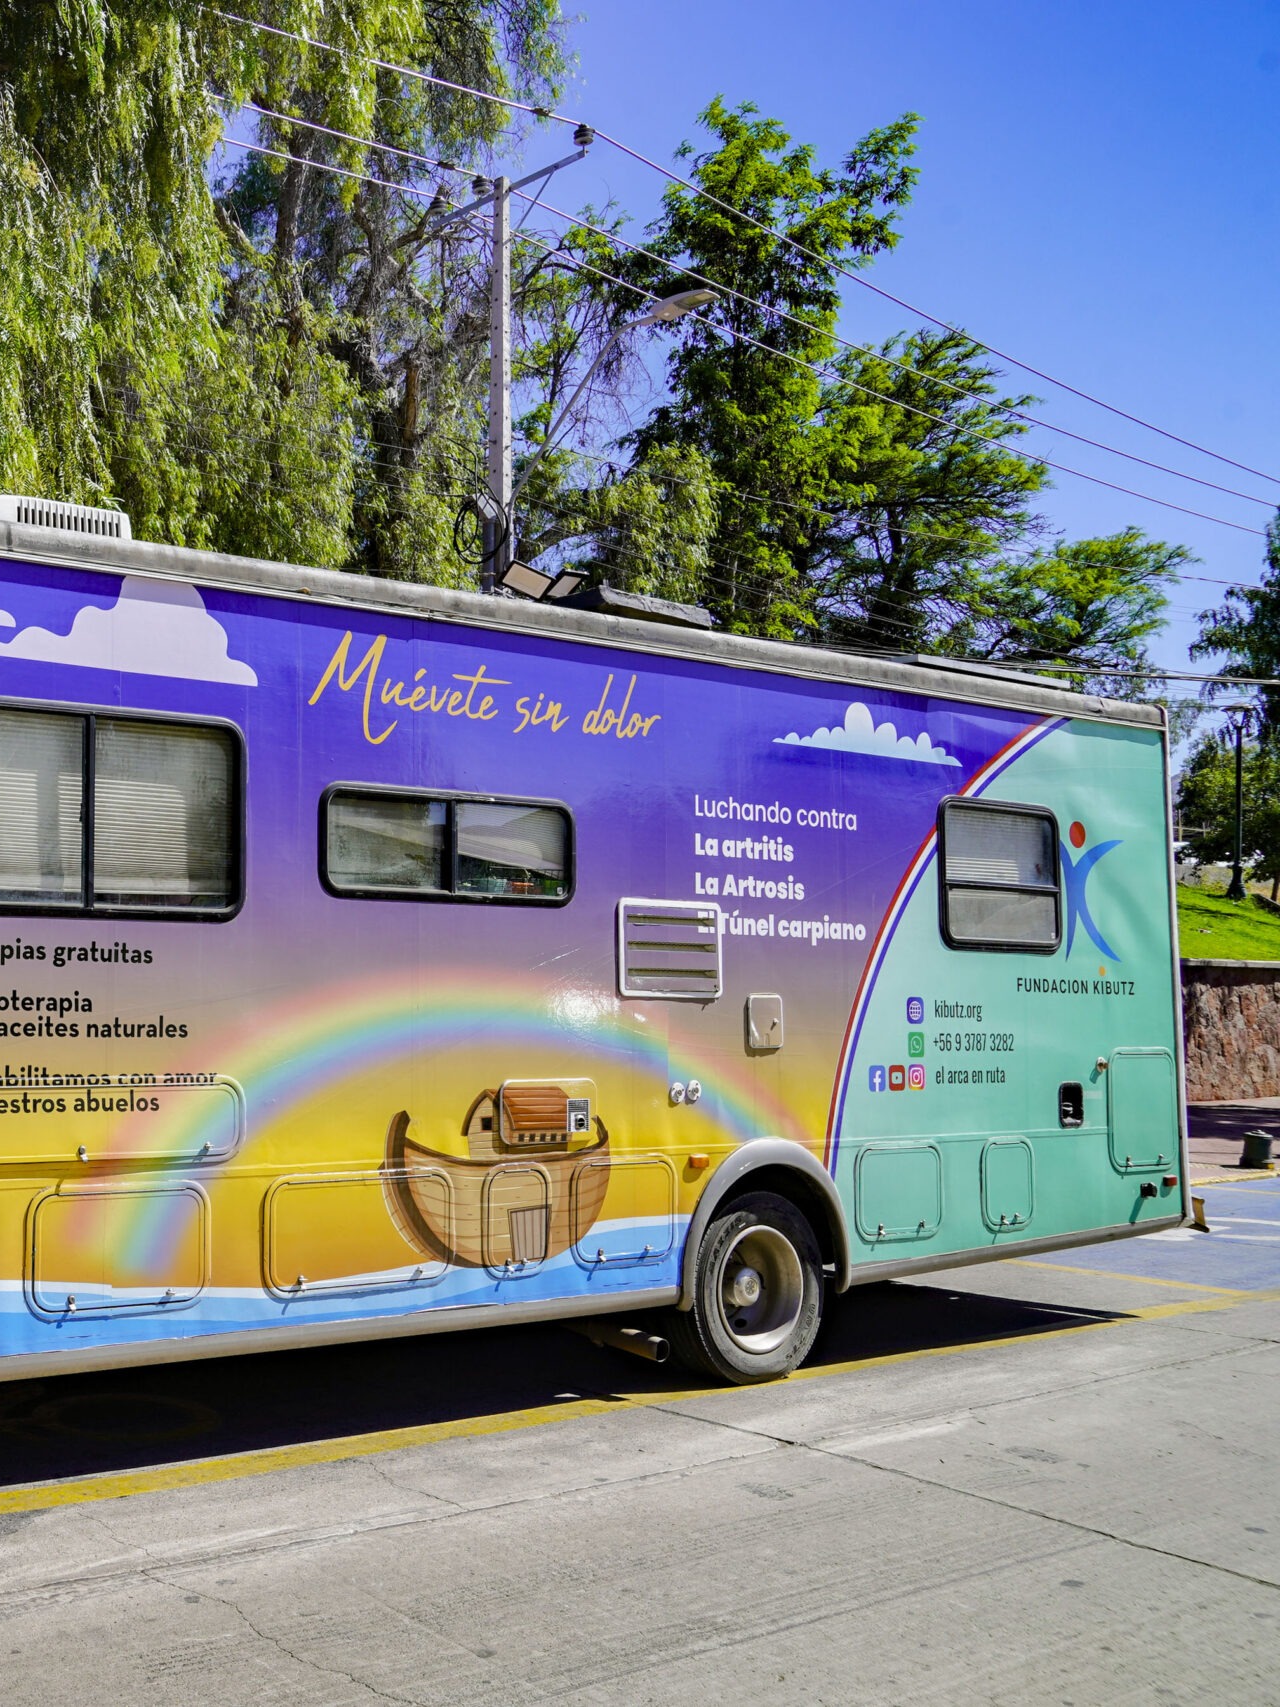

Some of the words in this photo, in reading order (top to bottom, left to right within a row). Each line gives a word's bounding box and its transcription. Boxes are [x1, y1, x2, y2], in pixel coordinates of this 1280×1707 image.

[308, 630, 513, 745] Muévete
[513, 692, 569, 734] sin
[582, 673, 662, 739] dolor
[694, 794, 792, 824] Luchando
[796, 807, 858, 831] contra
[694, 832, 719, 857] La
[722, 835, 795, 862] artritis
[694, 872, 719, 896] La
[722, 873, 805, 901] Artrosis
[718, 909, 775, 937] Túnel
[778, 914, 867, 946] carpiano
[52, 941, 154, 967] gratuitas
[1016, 977, 1089, 995] FUNDACION
[1093, 980, 1135, 996] KIBUTZ
[933, 1000, 983, 1022] kibutz.org
[86, 1015, 188, 1038] naturales
[932, 1031, 952, 1052] +56
[955, 1033, 962, 1052] 9
[964, 1033, 987, 1052] 3787
[989, 1033, 1014, 1052] 3282
[118, 1073, 156, 1086] con
[163, 1072, 217, 1086] amor
[935, 1066, 944, 1085] el
[947, 1070, 969, 1084] arca
[971, 1070, 985, 1084] en
[986, 1068, 1006, 1084] ruta
[73, 1090, 160, 1113] abuelos
